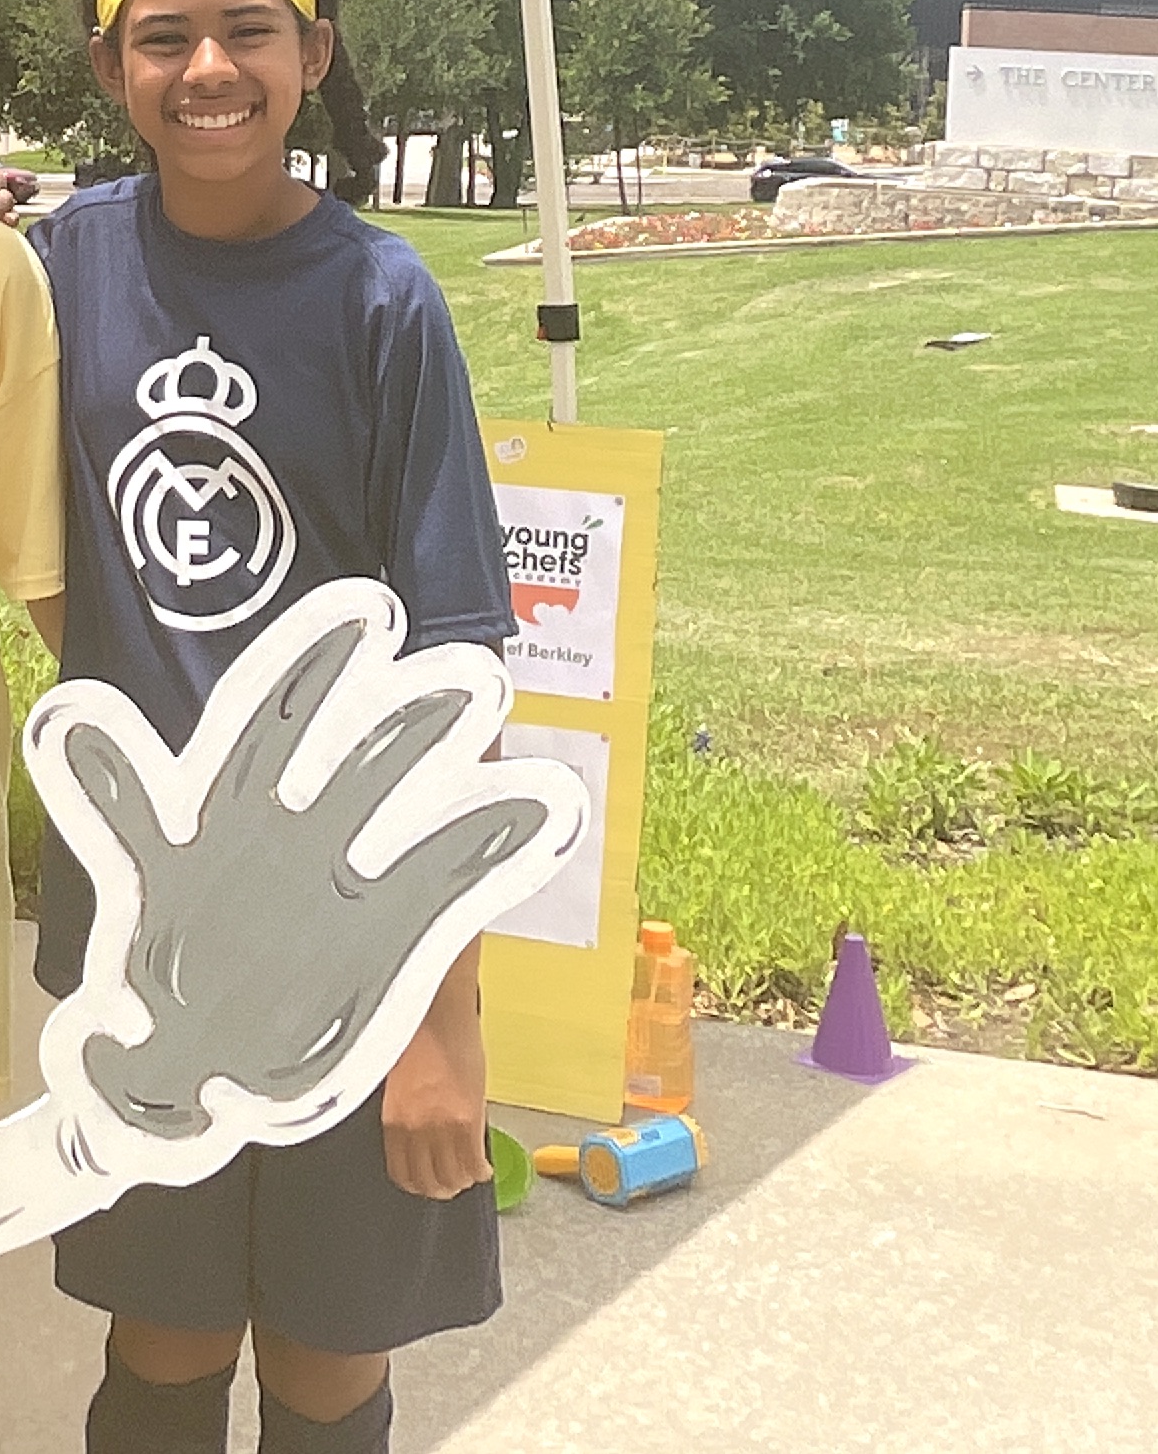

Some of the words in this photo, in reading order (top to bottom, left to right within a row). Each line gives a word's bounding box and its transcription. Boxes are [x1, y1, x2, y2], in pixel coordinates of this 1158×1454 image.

[1000, 64, 1047, 86] THE
[1061, 67, 1156, 91] CENTER
[501, 526, 589, 557] young
[506, 547, 581, 575] chefs
[513, 573, 581, 587] cademy
[507, 643, 523, 656] ef
